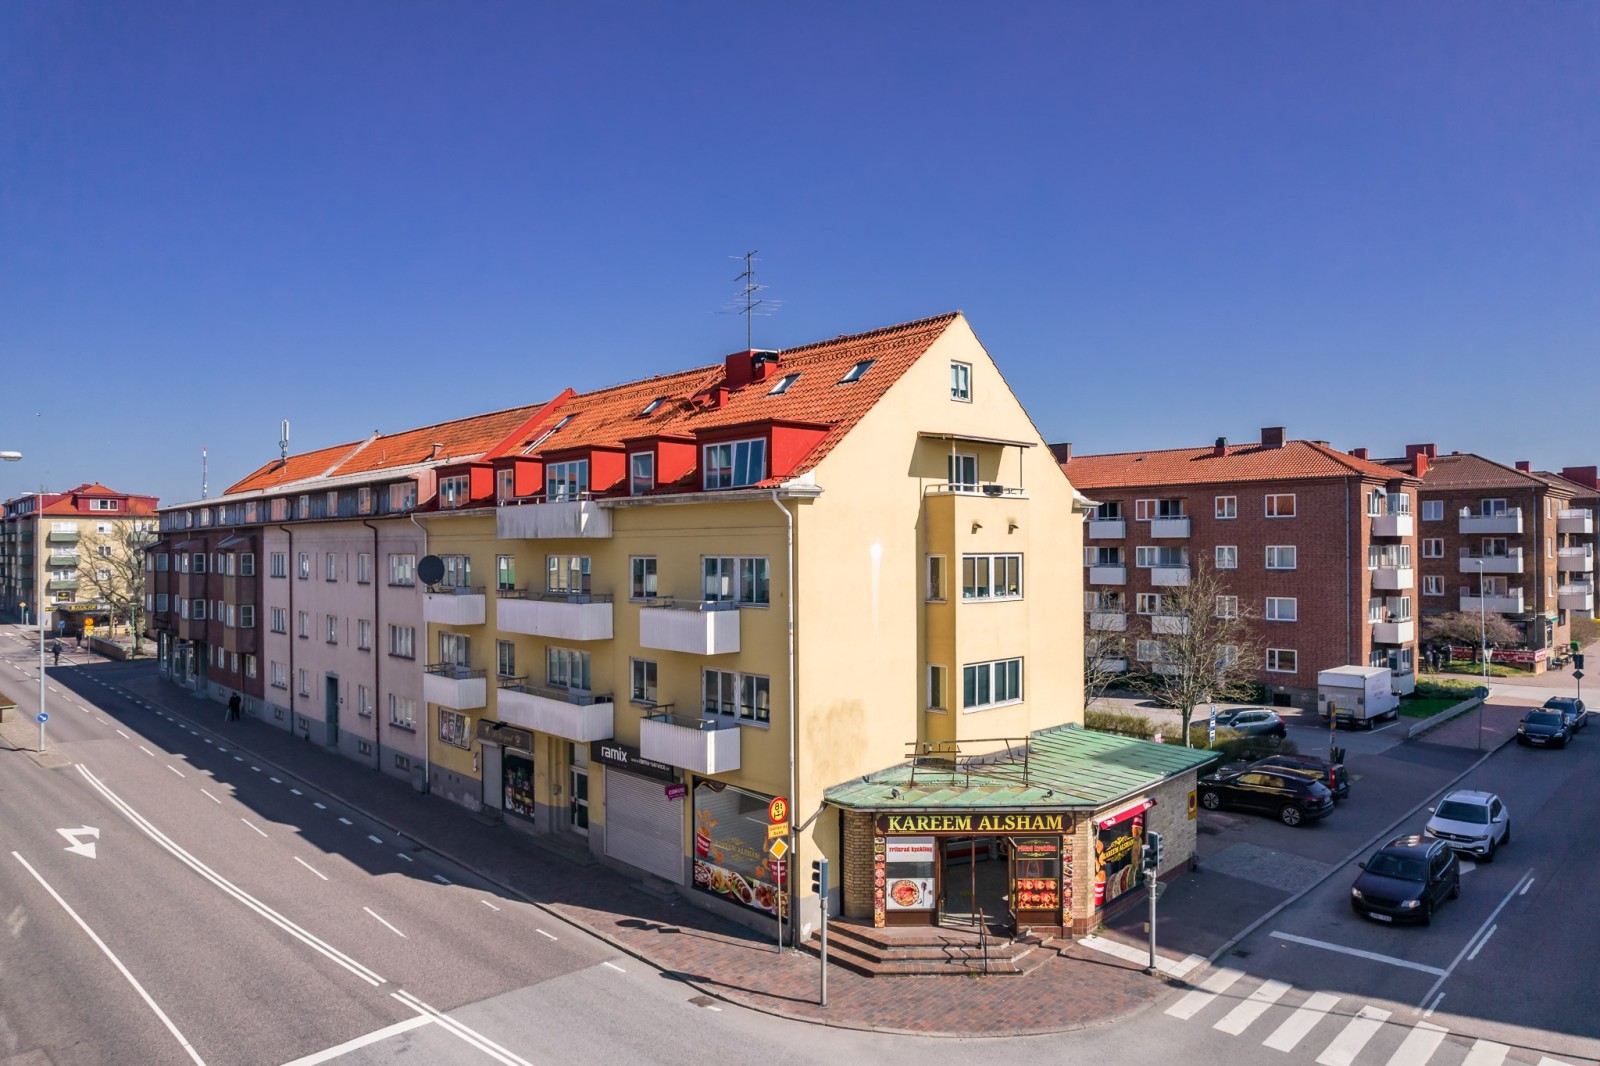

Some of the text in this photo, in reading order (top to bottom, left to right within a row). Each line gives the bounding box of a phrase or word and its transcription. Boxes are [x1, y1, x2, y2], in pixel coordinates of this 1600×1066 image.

[601, 745, 628, 762] ramix
[887, 815, 1063, 831] KAREEM ALSHAM
